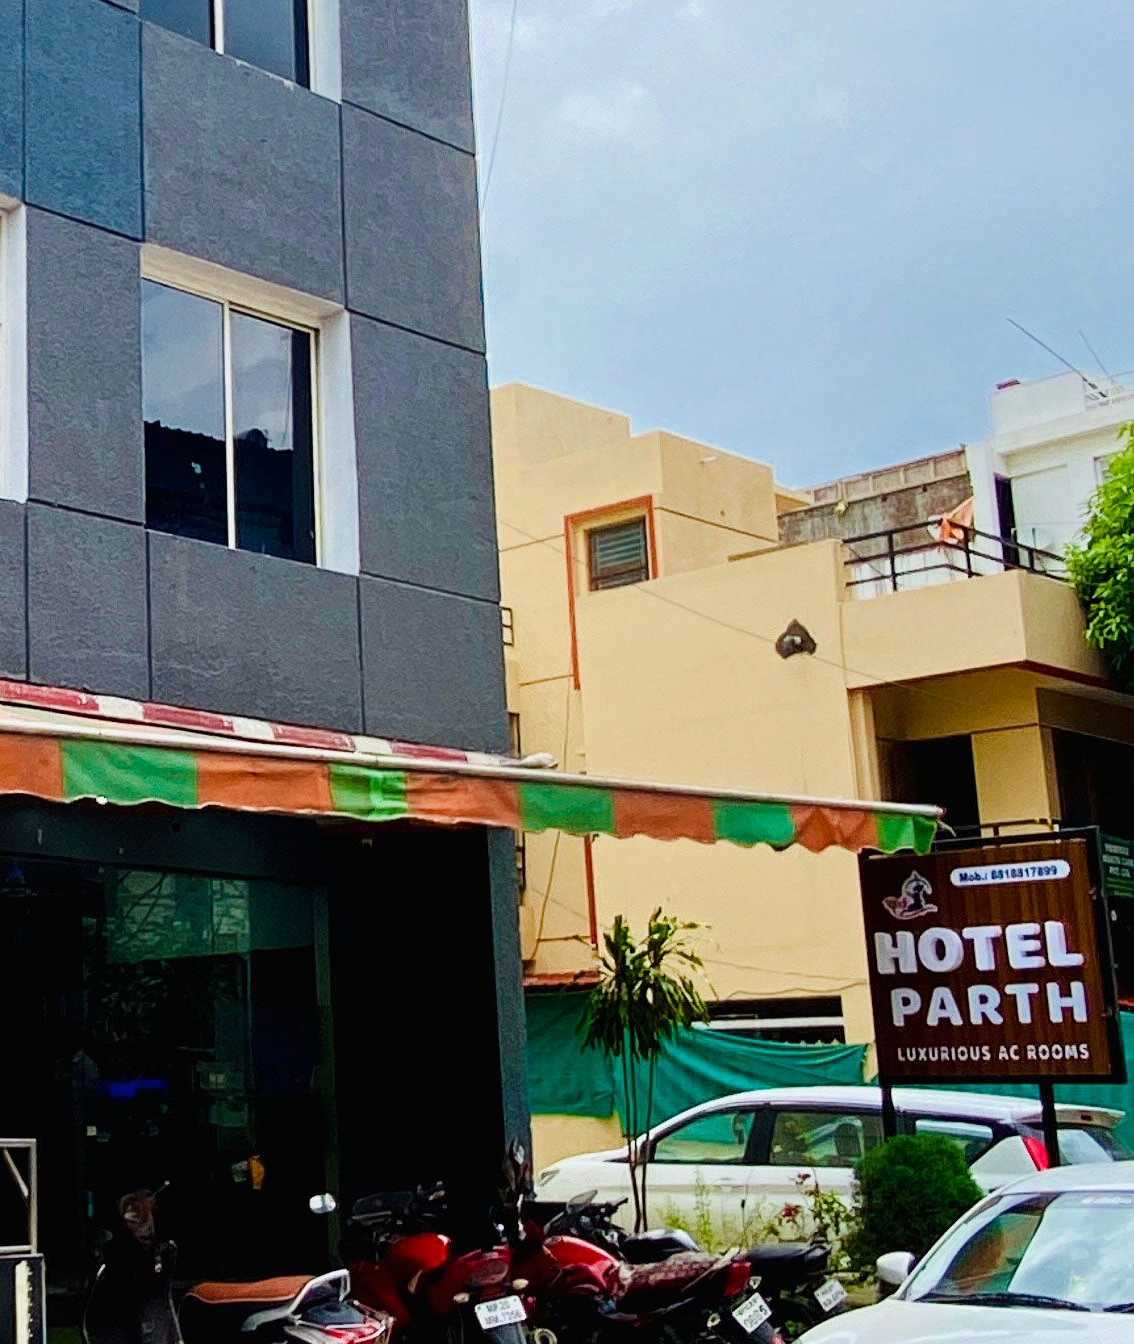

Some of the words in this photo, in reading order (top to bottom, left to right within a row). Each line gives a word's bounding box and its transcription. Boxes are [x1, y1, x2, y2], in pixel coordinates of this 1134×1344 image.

[874, 921, 1084, 975] HOTEL
[890, 981, 1088, 1027] PARTH
[897, 1045, 991, 1062] LUXURIOUS
[998, 1044, 1020, 1060] AC
[1027, 1044, 1090, 1060] ROOMS
